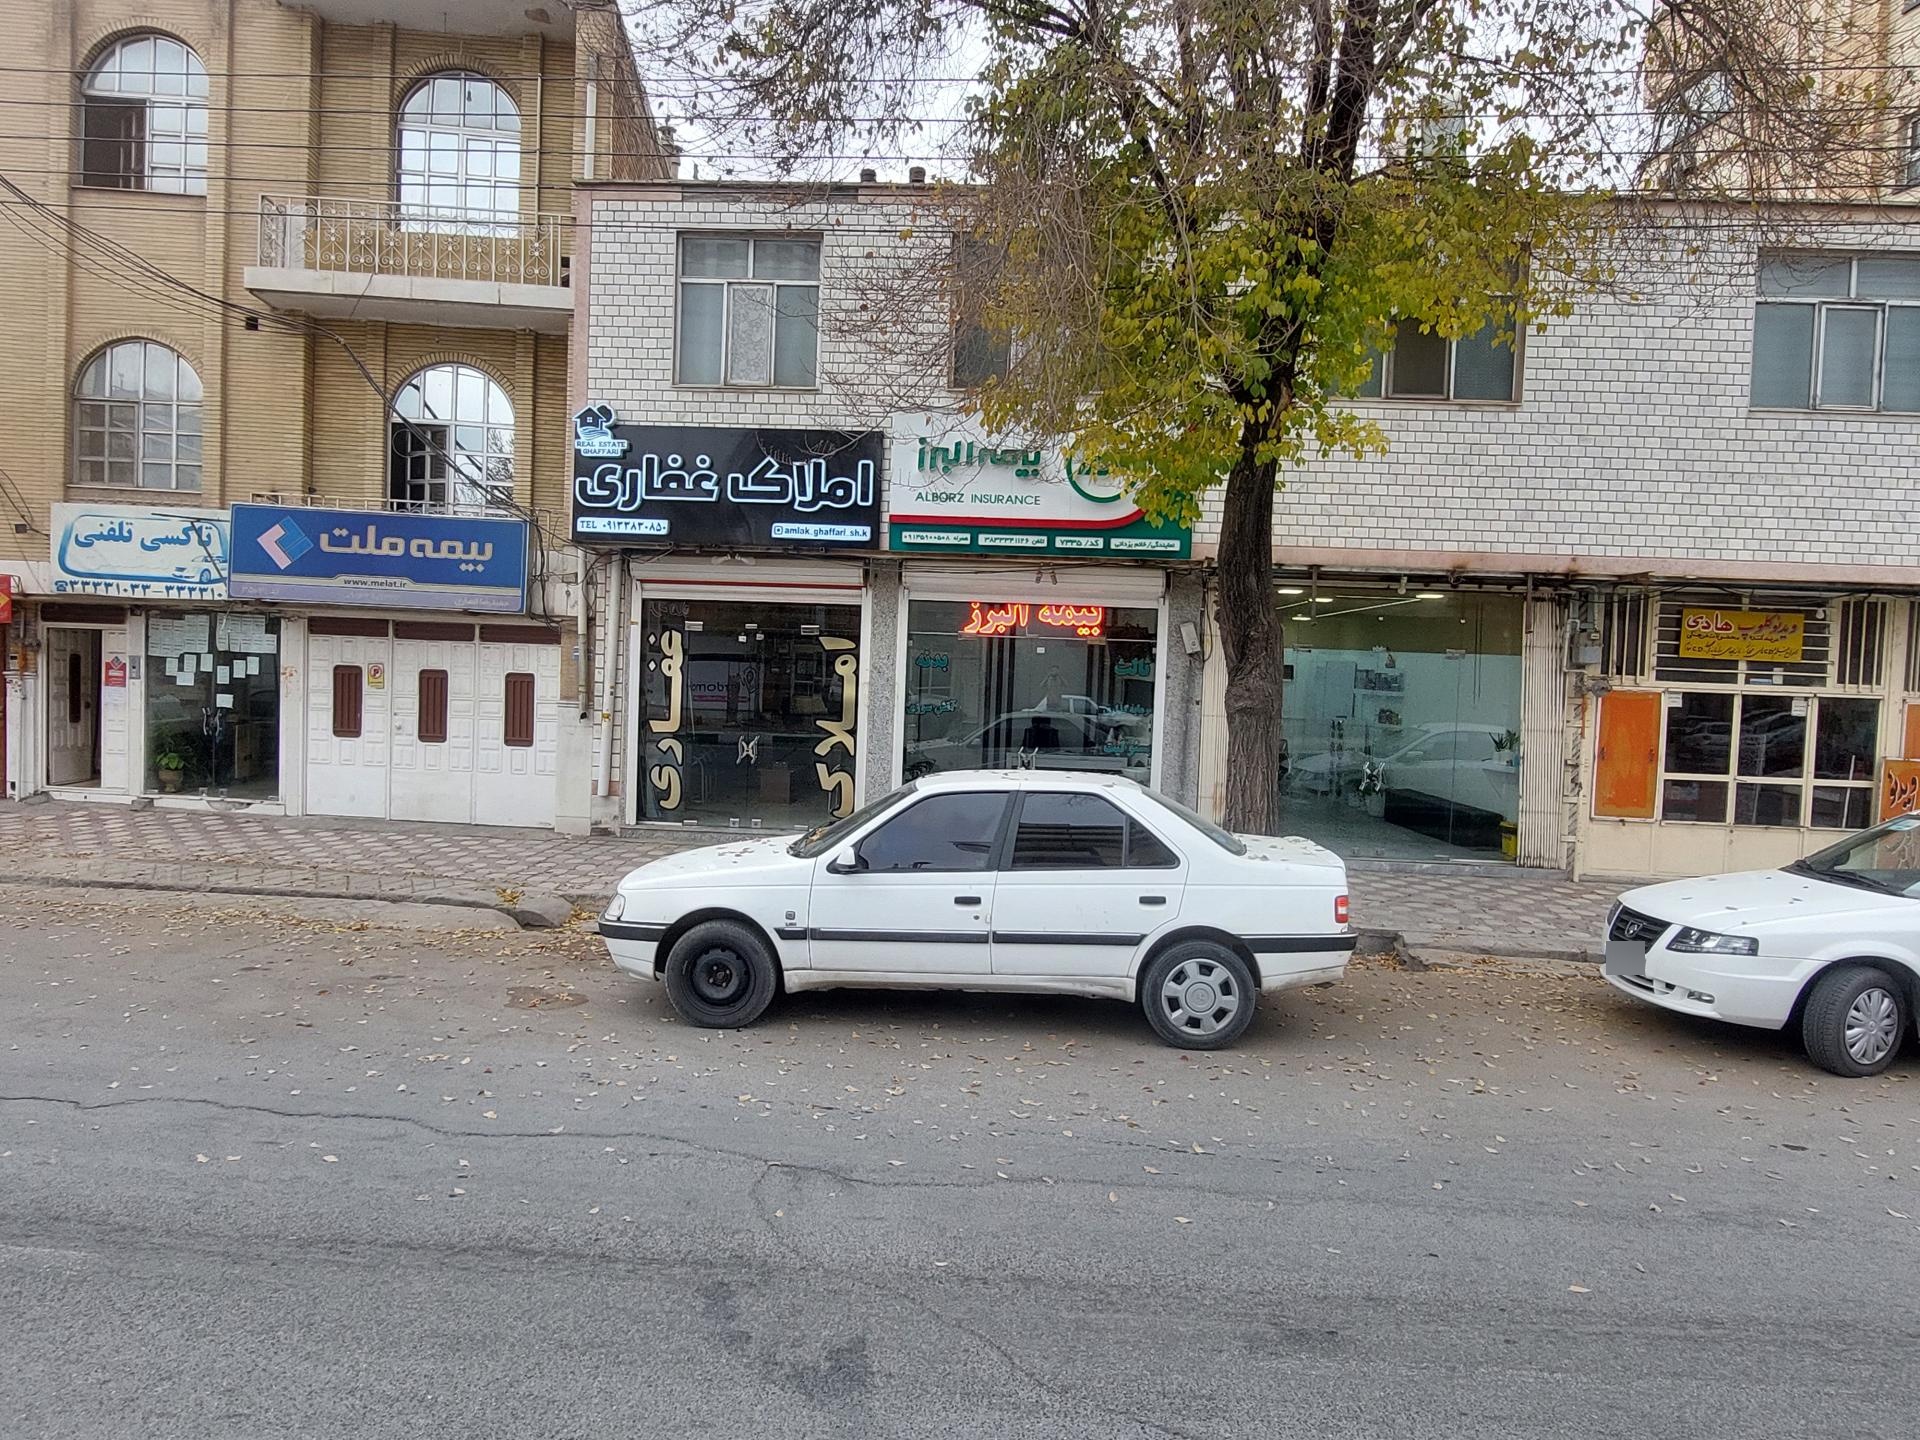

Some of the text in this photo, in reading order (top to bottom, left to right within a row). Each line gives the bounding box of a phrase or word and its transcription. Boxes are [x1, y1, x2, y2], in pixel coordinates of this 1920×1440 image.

[574, 453, 874, 513] املاک غفاری
[915, 491, 1041, 506] ALBORZ INSURANCE
[74, 519, 213, 552] تاکسی تلفنی
[579, 520, 598, 529] TEL
[319, 525, 493, 573] بیمه ملت
[343, 576, 408, 590] www.melat.ir
[963, 602, 1103, 637] بیمه البرز
[1685, 611, 1734, 634] هادی
[915, 649, 949, 672] بدنه
[1113, 655, 1151, 677] ثالث
